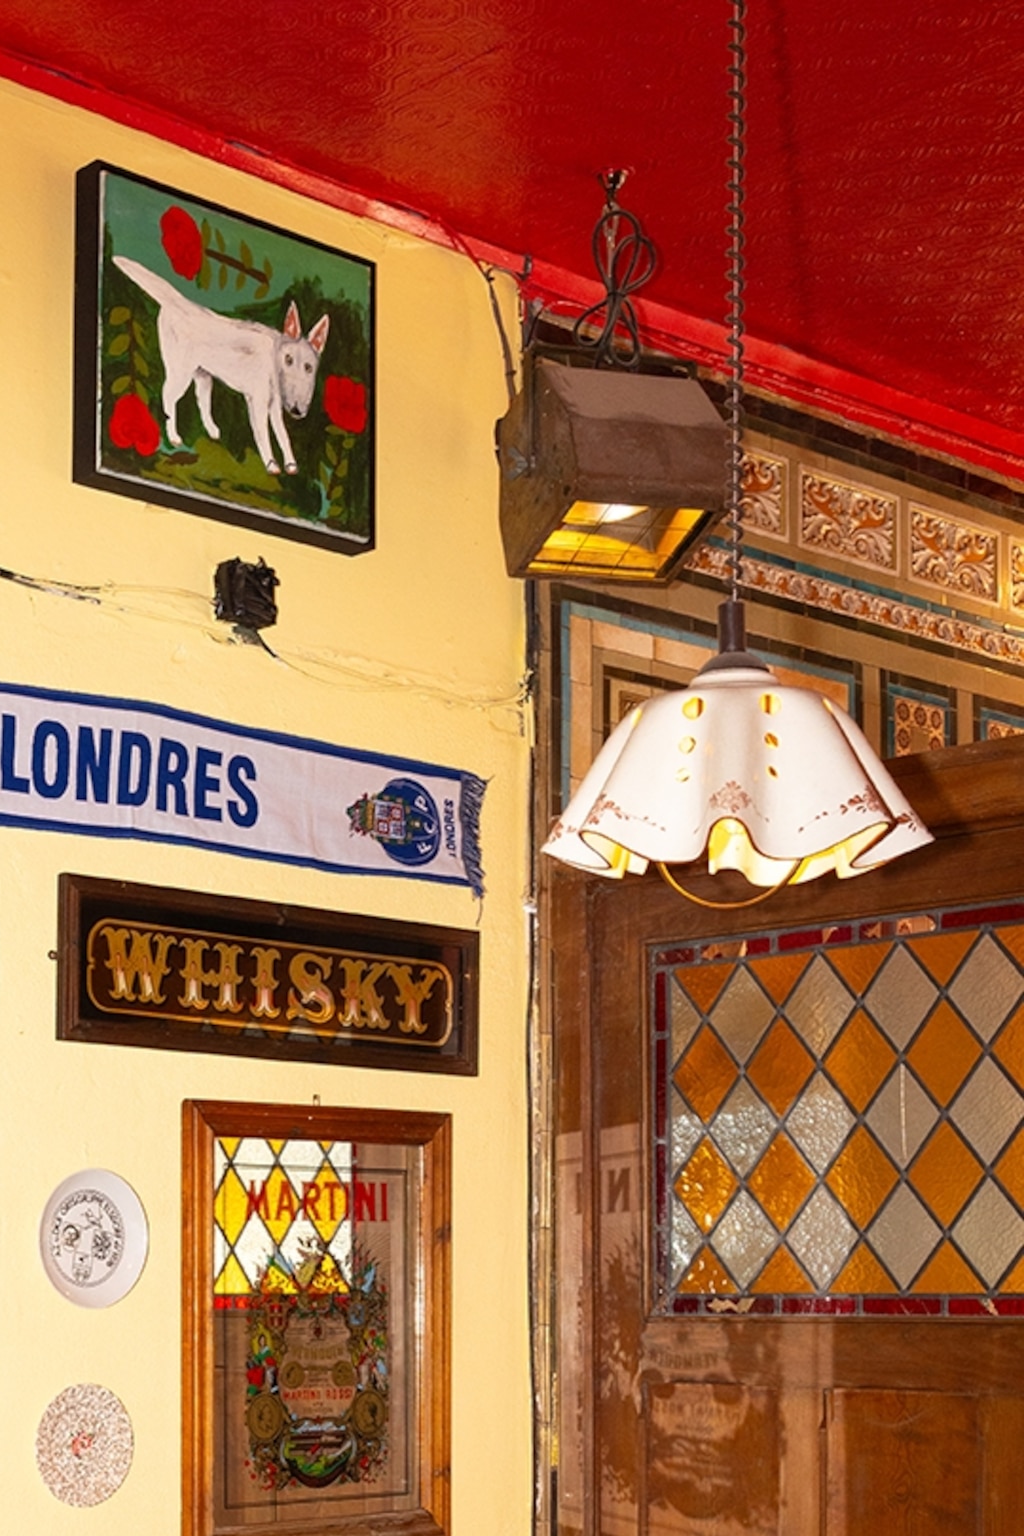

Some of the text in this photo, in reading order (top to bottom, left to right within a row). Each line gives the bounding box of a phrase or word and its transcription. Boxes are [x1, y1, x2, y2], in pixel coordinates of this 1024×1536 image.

[0, 712, 260, 830] LONDRES
[99, 926, 443, 1035] WHISKY
[246, 1179, 388, 1222] MARTINI
